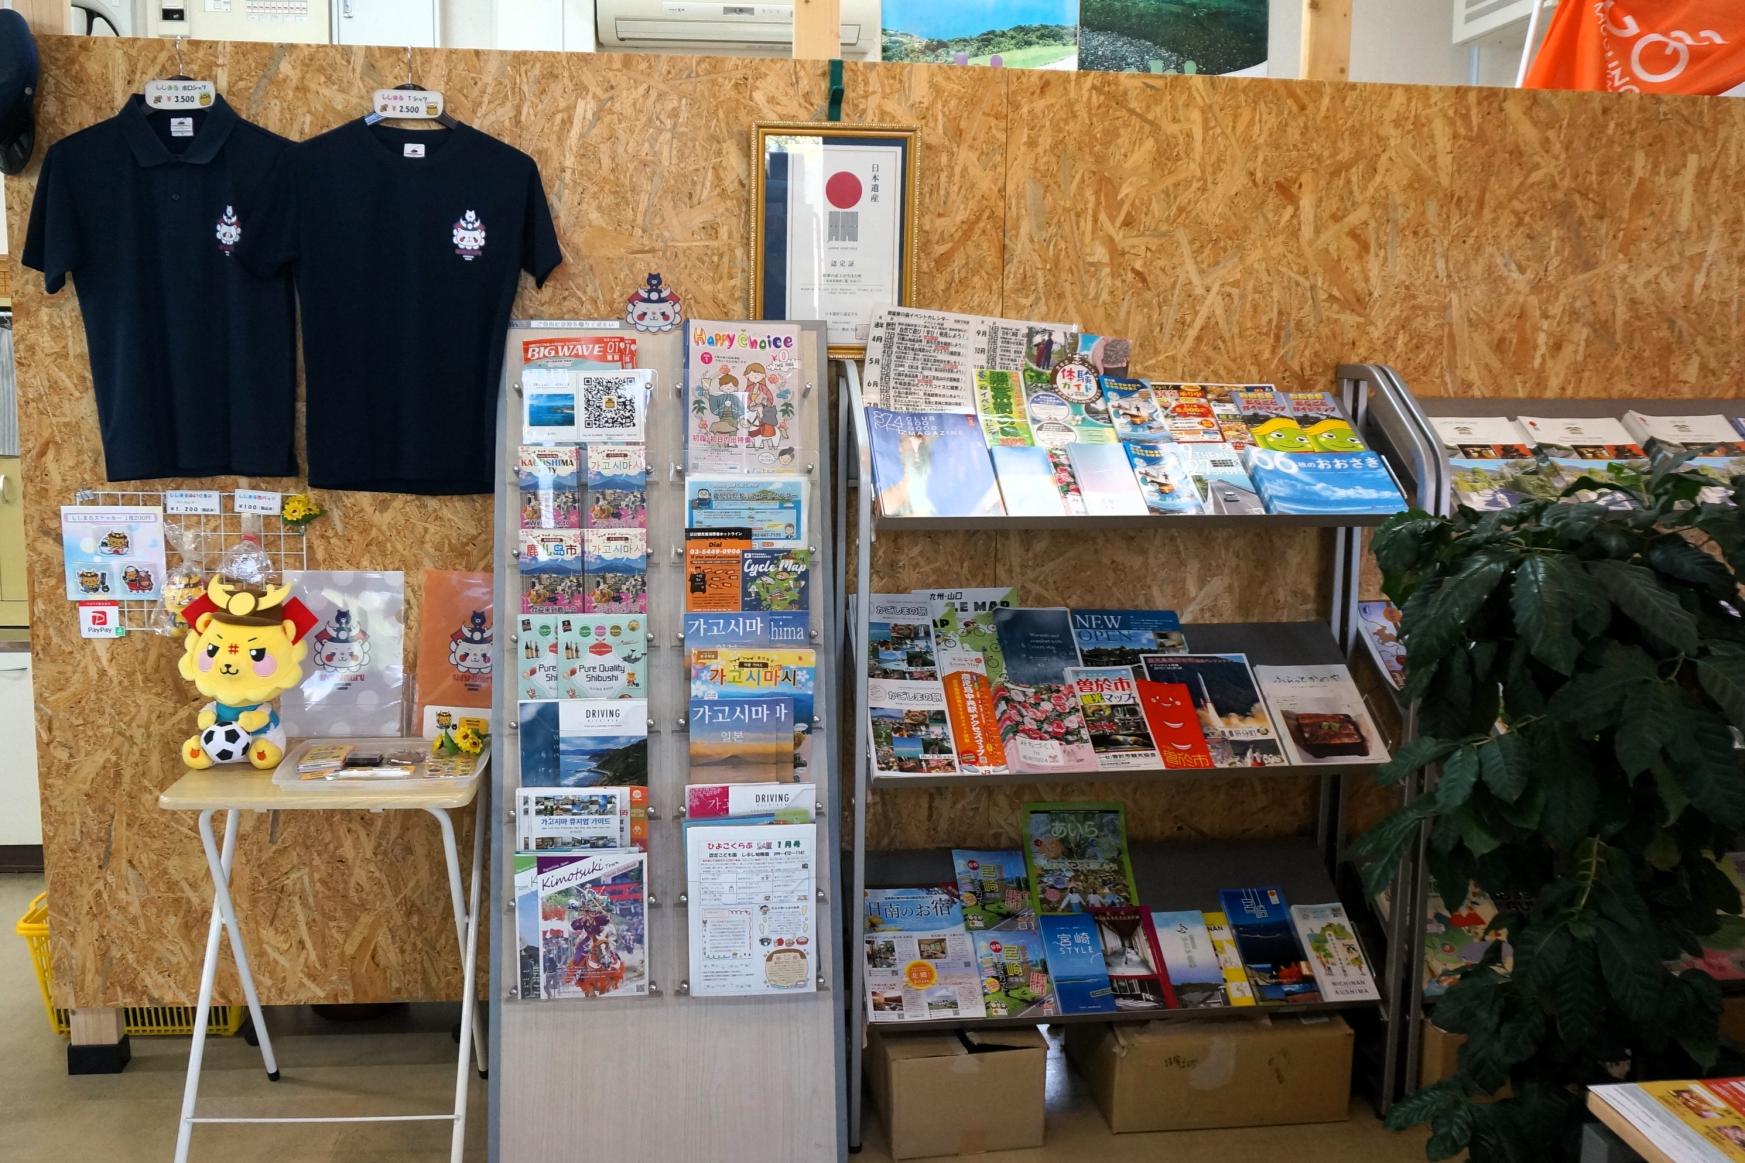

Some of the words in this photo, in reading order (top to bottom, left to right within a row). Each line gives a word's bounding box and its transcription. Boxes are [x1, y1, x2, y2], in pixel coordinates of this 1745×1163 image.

[870, 163, 880, 203] 日本遺産
[694, 328, 736, 350] Happy
[738, 328, 793, 350] Choice
[528, 344, 556, 360] BIG
[559, 344, 604, 356] WAVE
[744, 559, 776, 576] Cycle
[779, 559, 806, 575] Map
[875, 606, 928, 617] かごしまの旅
[688, 616, 764, 637] 가고시마
[1075, 614, 1122, 629] NEW
[1078, 630, 1132, 642] OPEN
[538, 664, 556, 672] Pure
[578, 664, 596, 672] Pure
[599, 664, 626, 674] Quality
[586, 674, 618, 682] Shibushi
[710, 668, 796, 686] 가고시마시
[1076, 678, 1132, 692] 曽於市
[586, 708, 620, 718] DRIVING
[692, 704, 770, 724] 가고시마
[720, 730, 744, 742] 일본
[756, 794, 790, 803] DRIVING
[541, 818, 568, 826] 가고시마
[570, 818, 588, 826] 뮤지엄
[1050, 822, 1098, 838] あいら
[778, 840, 800, 848] 1月号
[542, 858, 604, 890] Kimotsuki
[868, 898, 951, 918] 日南のお宿
[1057, 931, 1090, 947] 宮崎
[1060, 946, 1094, 954] STYLE
